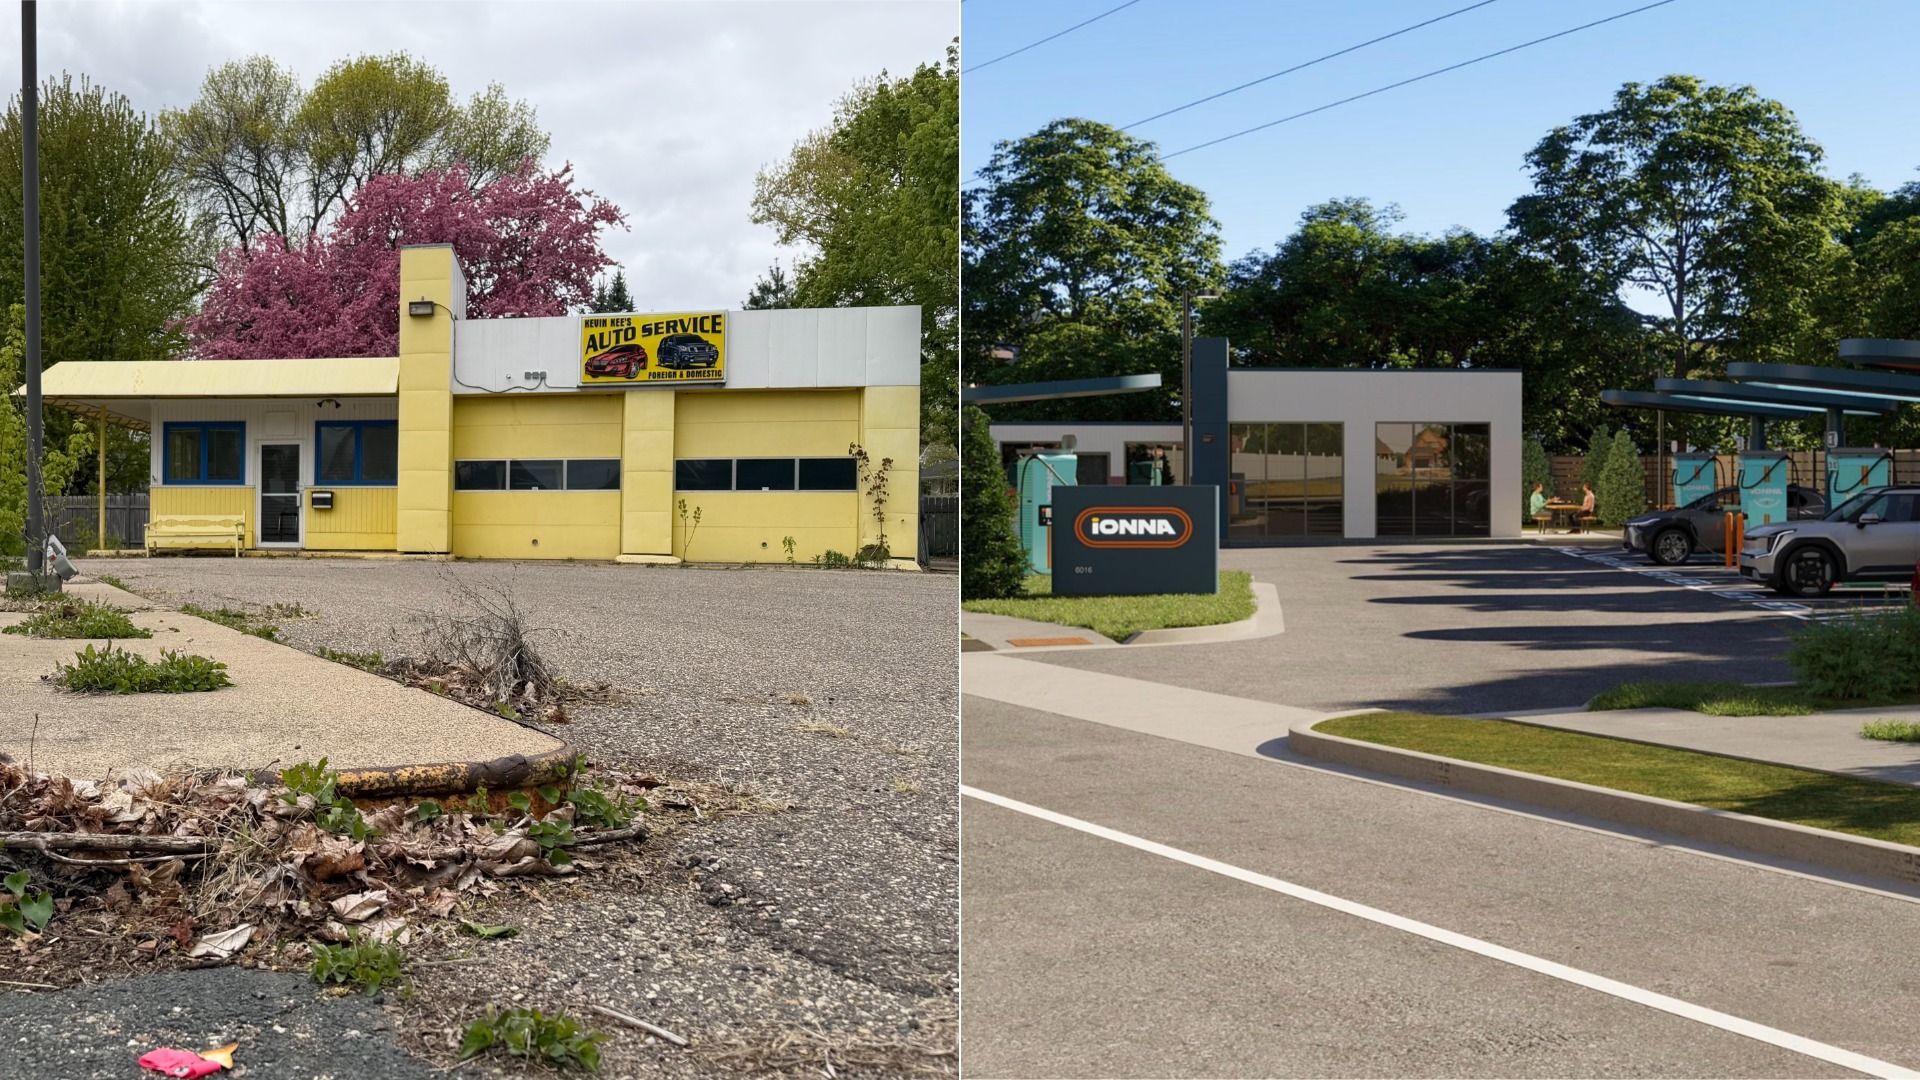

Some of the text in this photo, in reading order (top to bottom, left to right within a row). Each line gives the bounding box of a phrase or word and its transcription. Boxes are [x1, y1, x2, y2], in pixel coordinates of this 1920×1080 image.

[584, 318, 607, 328] KEVIN
[585, 314, 722, 354] AUTO SERVICE
[648, 369, 722, 379] FOREIGN & DOMESTIC
[1074, 566, 1093, 574] 6016
